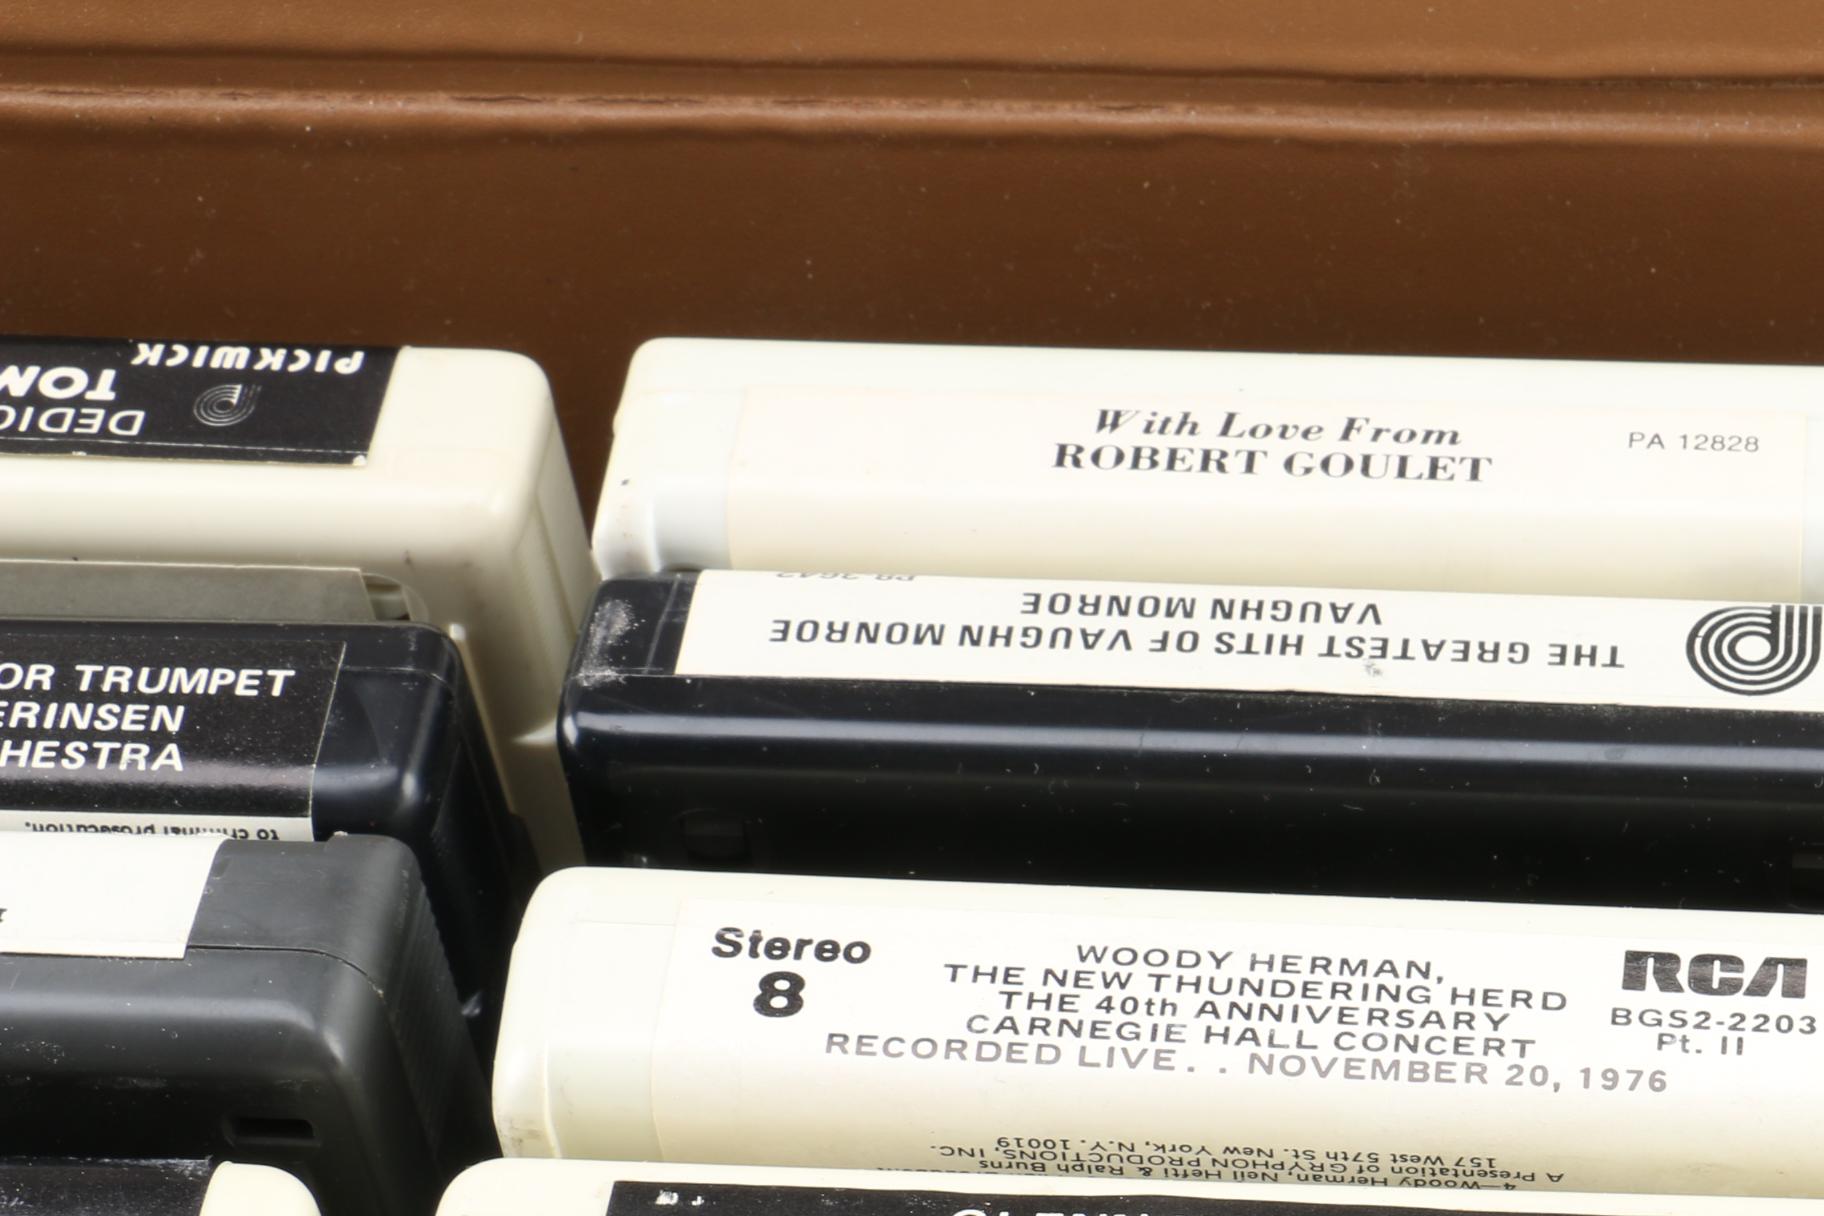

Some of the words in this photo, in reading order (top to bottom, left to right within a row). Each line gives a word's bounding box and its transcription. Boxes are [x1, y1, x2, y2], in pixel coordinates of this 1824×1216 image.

[131, 343, 364, 374] PICKWICK
[1097, 410, 1198, 435] With
[1219, 412, 1323, 440] Love
[1340, 418, 1458, 445] From
[1629, 432, 1664, 449] PA
[1681, 434, 1759, 452] 12828
[1055, 444, 1267, 473] ROBERT
[1284, 454, 1491, 481] GOULET
[1022, 593, 1195, 618] MONROE
[1211, 599, 1381, 625] VAUGHN
[770, 620, 945, 645] MONROE
[959, 625, 1131, 650] VAUGHN
[1150, 631, 1199, 652] OF
[1215, 632, 1303, 655] HITS
[1319, 636, 1529, 664] GREATEST
[1548, 644, 1624, 668] THE
[76, 665, 295, 696] TRUMPET
[712, 927, 871, 964] Stereo
[1077, 945, 1232, 969] WOODY
[1250, 953, 1443, 984] HERMAN,
[1622, 950, 1807, 998] RCA
[754, 972, 805, 1017] 8
[945, 964, 1025, 985] THE
[1043, 969, 1132, 990] NEW
[1148, 974, 1432, 1005] THUNDERING
[1451, 987, 1566, 1010] HERD
[999, 991, 1080, 1013] THE
[1096, 996, 1177, 1016] 40th
[1195, 1001, 1510, 1031] ANNIVERSARY
[1611, 1008, 1816, 1034] BGS2-2203
[967, 1015, 1186, 1043] CARNEGIE
[1204, 1025, 1317, 1049] HALL
[1334, 1032, 1535, 1058] CONCERT
[1657, 1033, 1702, 1053] Pt.
[1721, 1036, 1743, 1055] II
[825, 1033, 1061, 1066] RECORDED
[1249, 1053, 1487, 1084] NOVEMBER
[1505, 1064, 1560, 1093] 20,
[1580, 1068, 1666, 1092] 1976
[930, 1145, 985, 1158] INC.
[997, 1136, 1070, 1150] 10019
[1223, 1148, 1273, 1158] New
[1284, 1148, 1314, 1160] St.
[979, 1160, 1046, 1172] Burns
[995, 1146, 1200, 1168] PRODUCTIONS,
[1212, 1158, 1347, 1174] GRYPHON
[1326, 1151, 1380, 1163] 57th
[1390, 1153, 1444, 1166] West
[1455, 1156, 1496, 1169] 157
[1057, 1163, 1124, 1176] Ralph
[1165, 1168, 1222, 1180] Hefti
[1233, 1170, 1278, 1183] Neil
[1287, 1172, 1388, 1187] Herman,
[1356, 1163, 1380, 1175] of
[1391, 1164, 1535, 1181] Presentation
[1545, 1173, 1564, 1184] A
